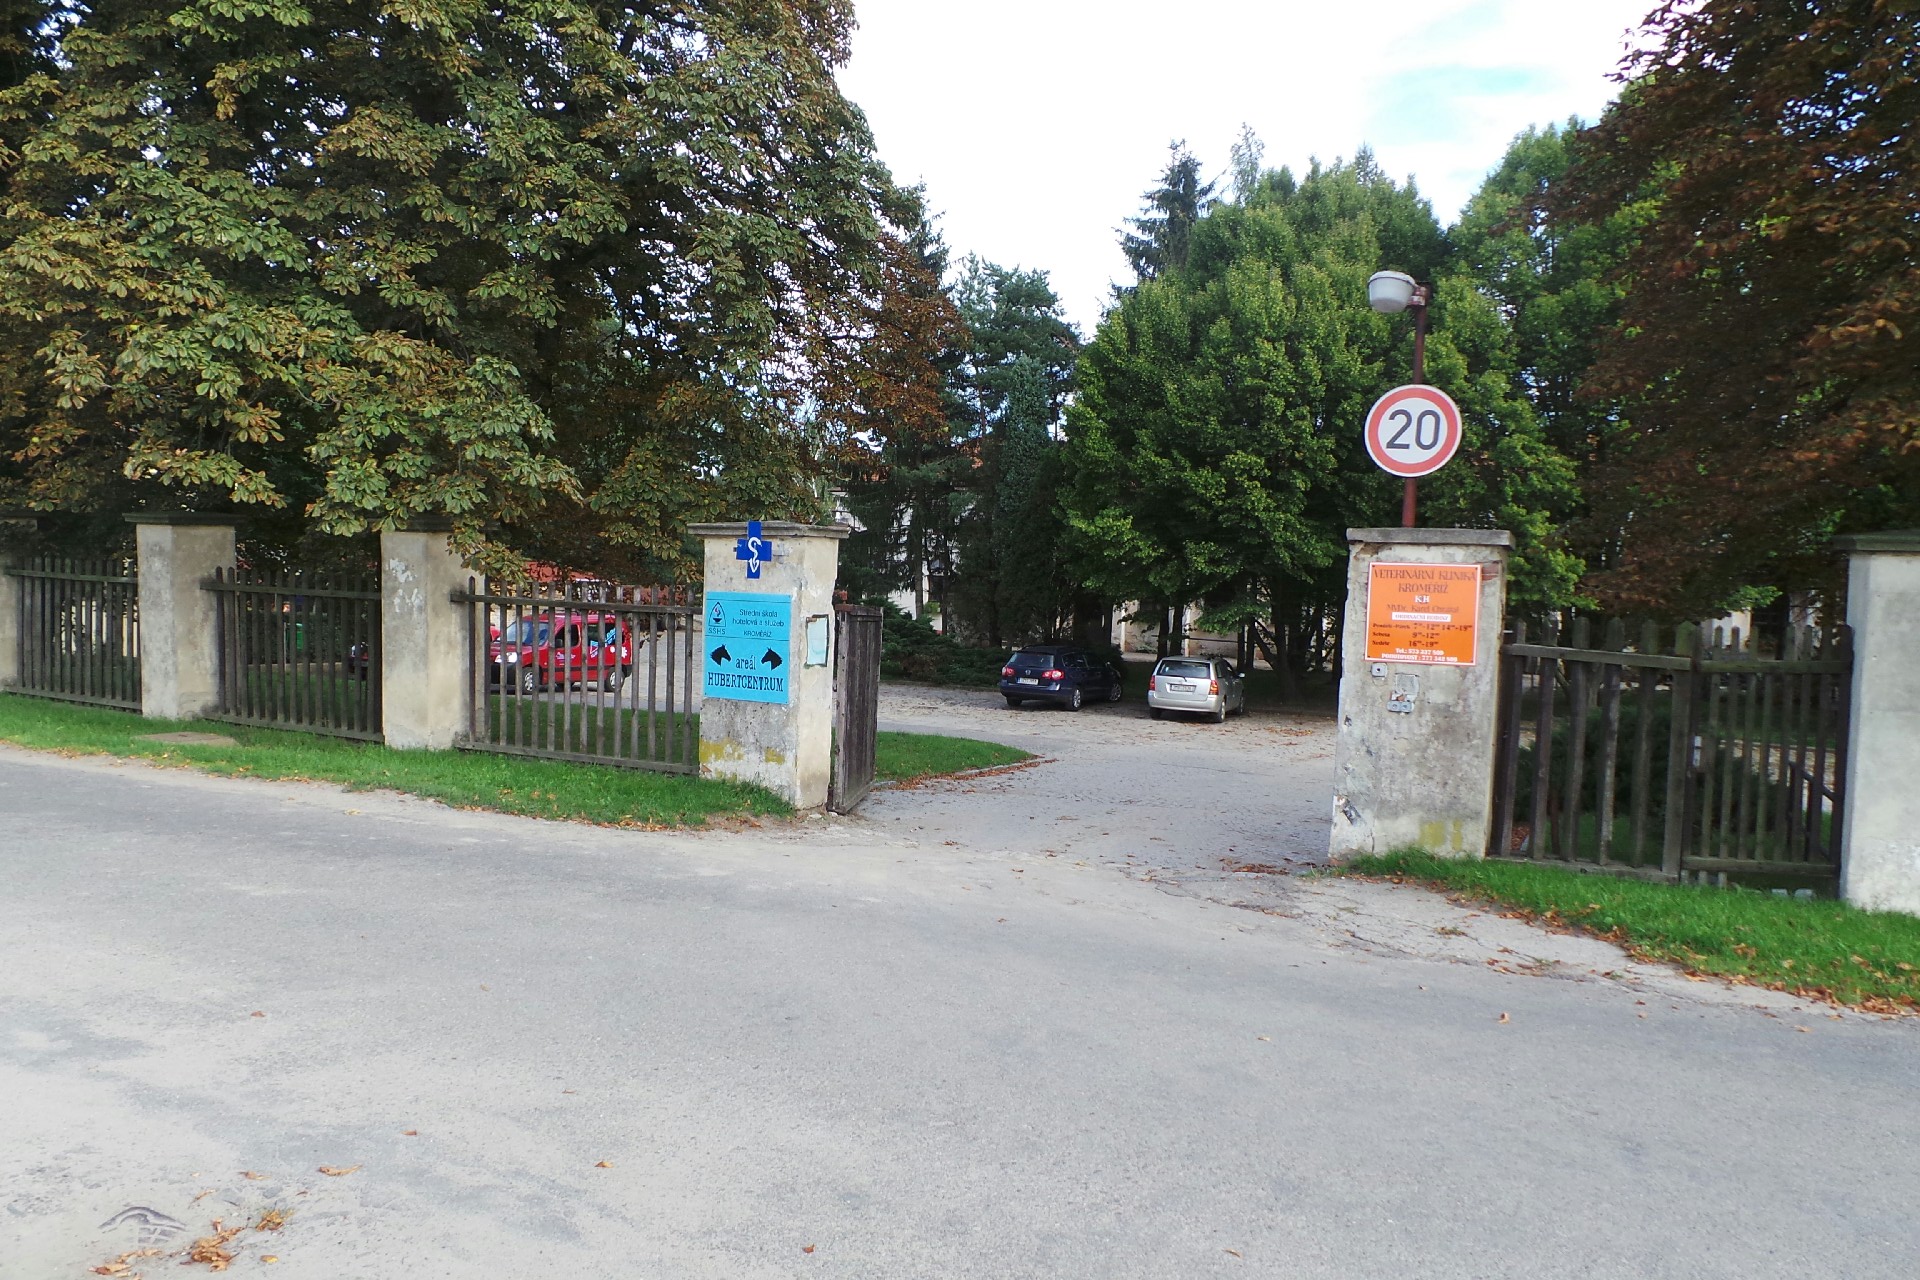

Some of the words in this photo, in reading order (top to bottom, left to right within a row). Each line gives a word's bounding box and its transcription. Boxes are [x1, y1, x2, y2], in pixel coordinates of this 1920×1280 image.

[386, 409, 440, 450] 20
[1439, 570, 1477, 581] KLINIKA
[735, 655, 756, 670] areál
[708, 672, 783, 692] HUBERTCENTRUM
